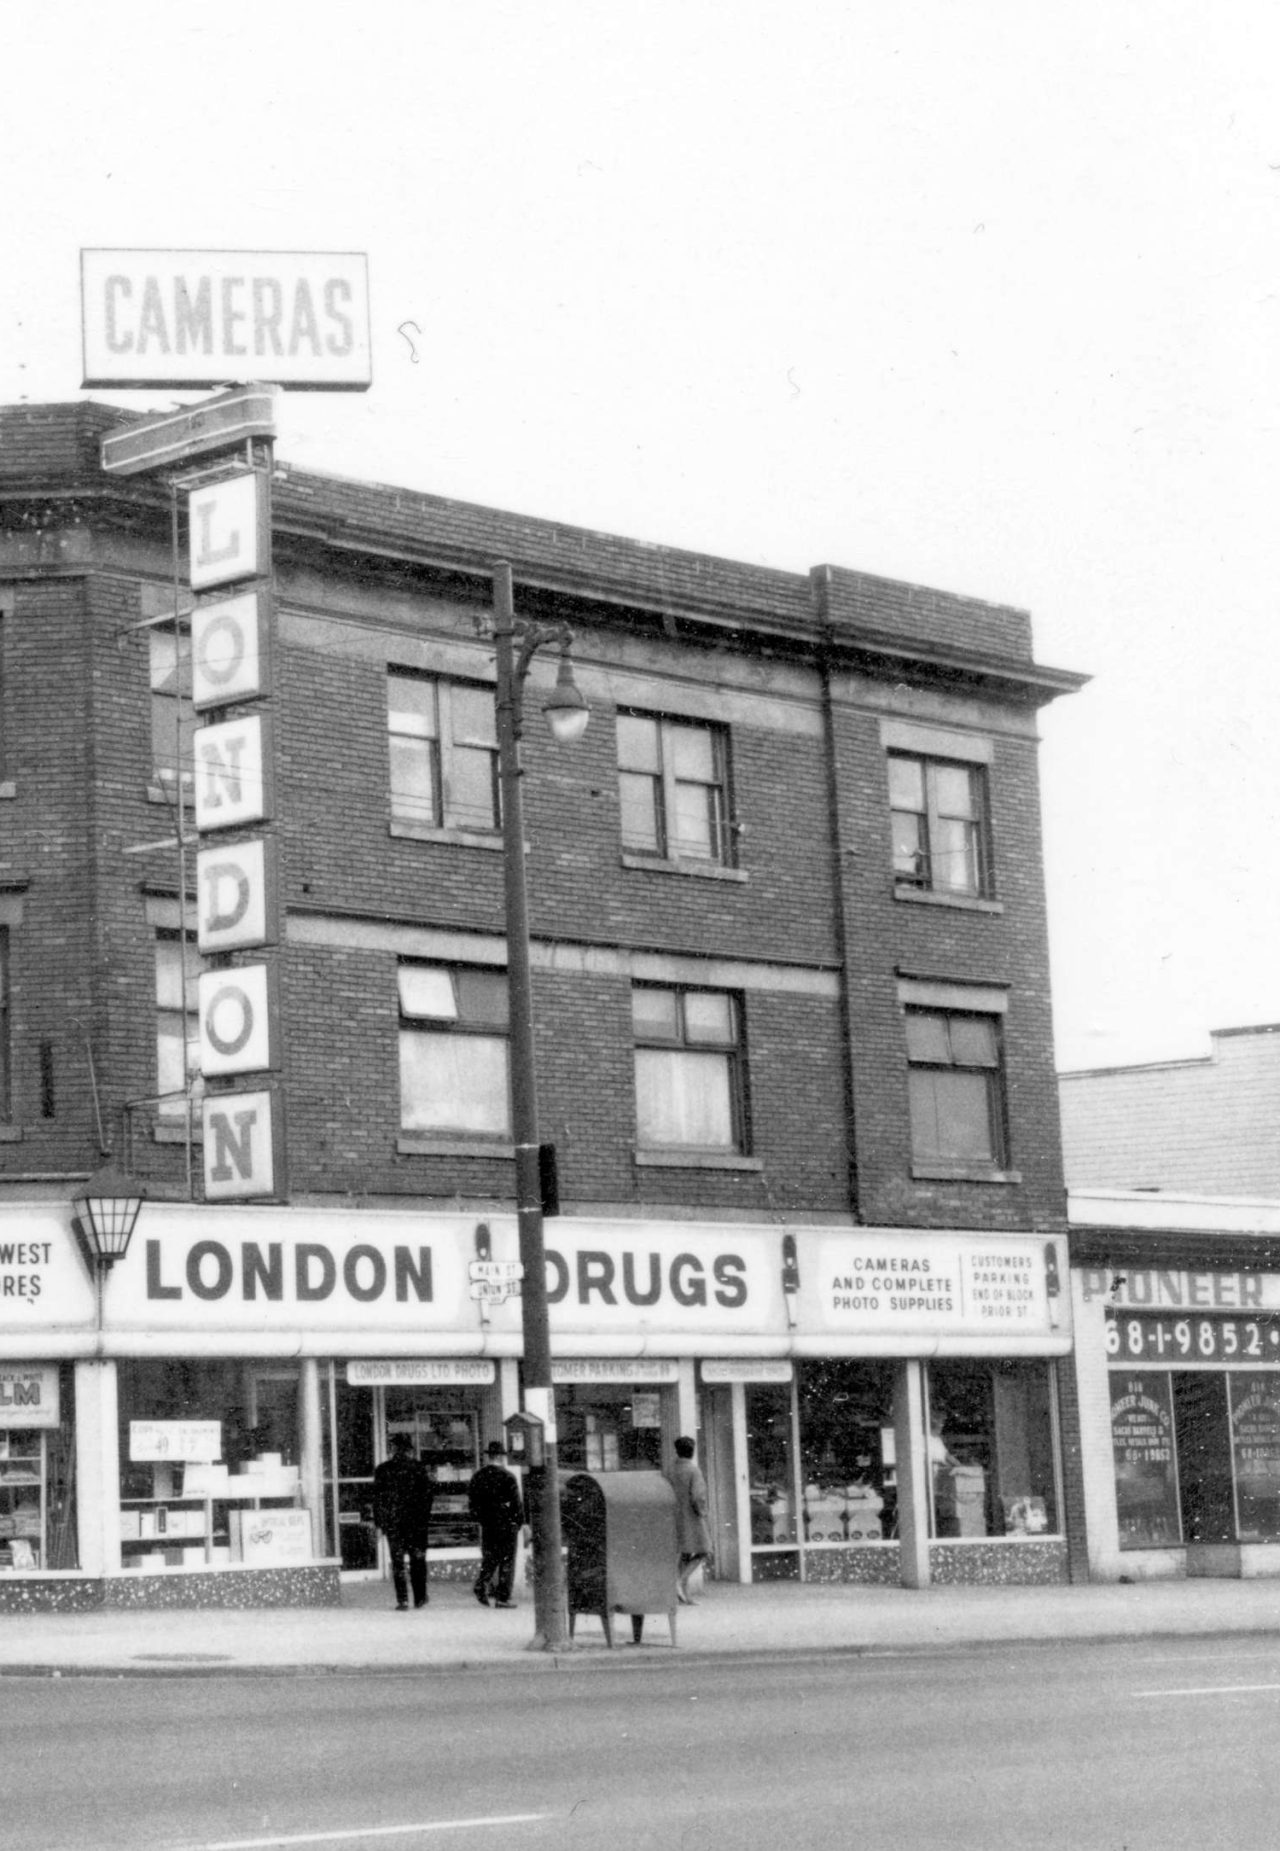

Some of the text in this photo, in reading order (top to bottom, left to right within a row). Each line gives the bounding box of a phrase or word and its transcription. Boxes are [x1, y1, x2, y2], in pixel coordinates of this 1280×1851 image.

[104, 274, 355, 357] CAMERAS
[195, 501, 257, 1183] LONDON
[853, 1257, 931, 1272] CAMERAS
[971, 1256, 1032, 1268] CUSTOMERS
[146, 1239, 748, 1308] LONDON DRUGS
[974, 1272, 1030, 1285] PARKING
[832, 1276, 952, 1292] AND COMPLETE
[1082, 1268, 1263, 1307] PIONEER
[833, 1296, 953, 1311] PHOTO SUPPLIES
[981, 1305, 1012, 1318] PRIOR
[551, 1360, 586, 1378] TOMER
[1111, 1394, 1136, 1418] ONEER
